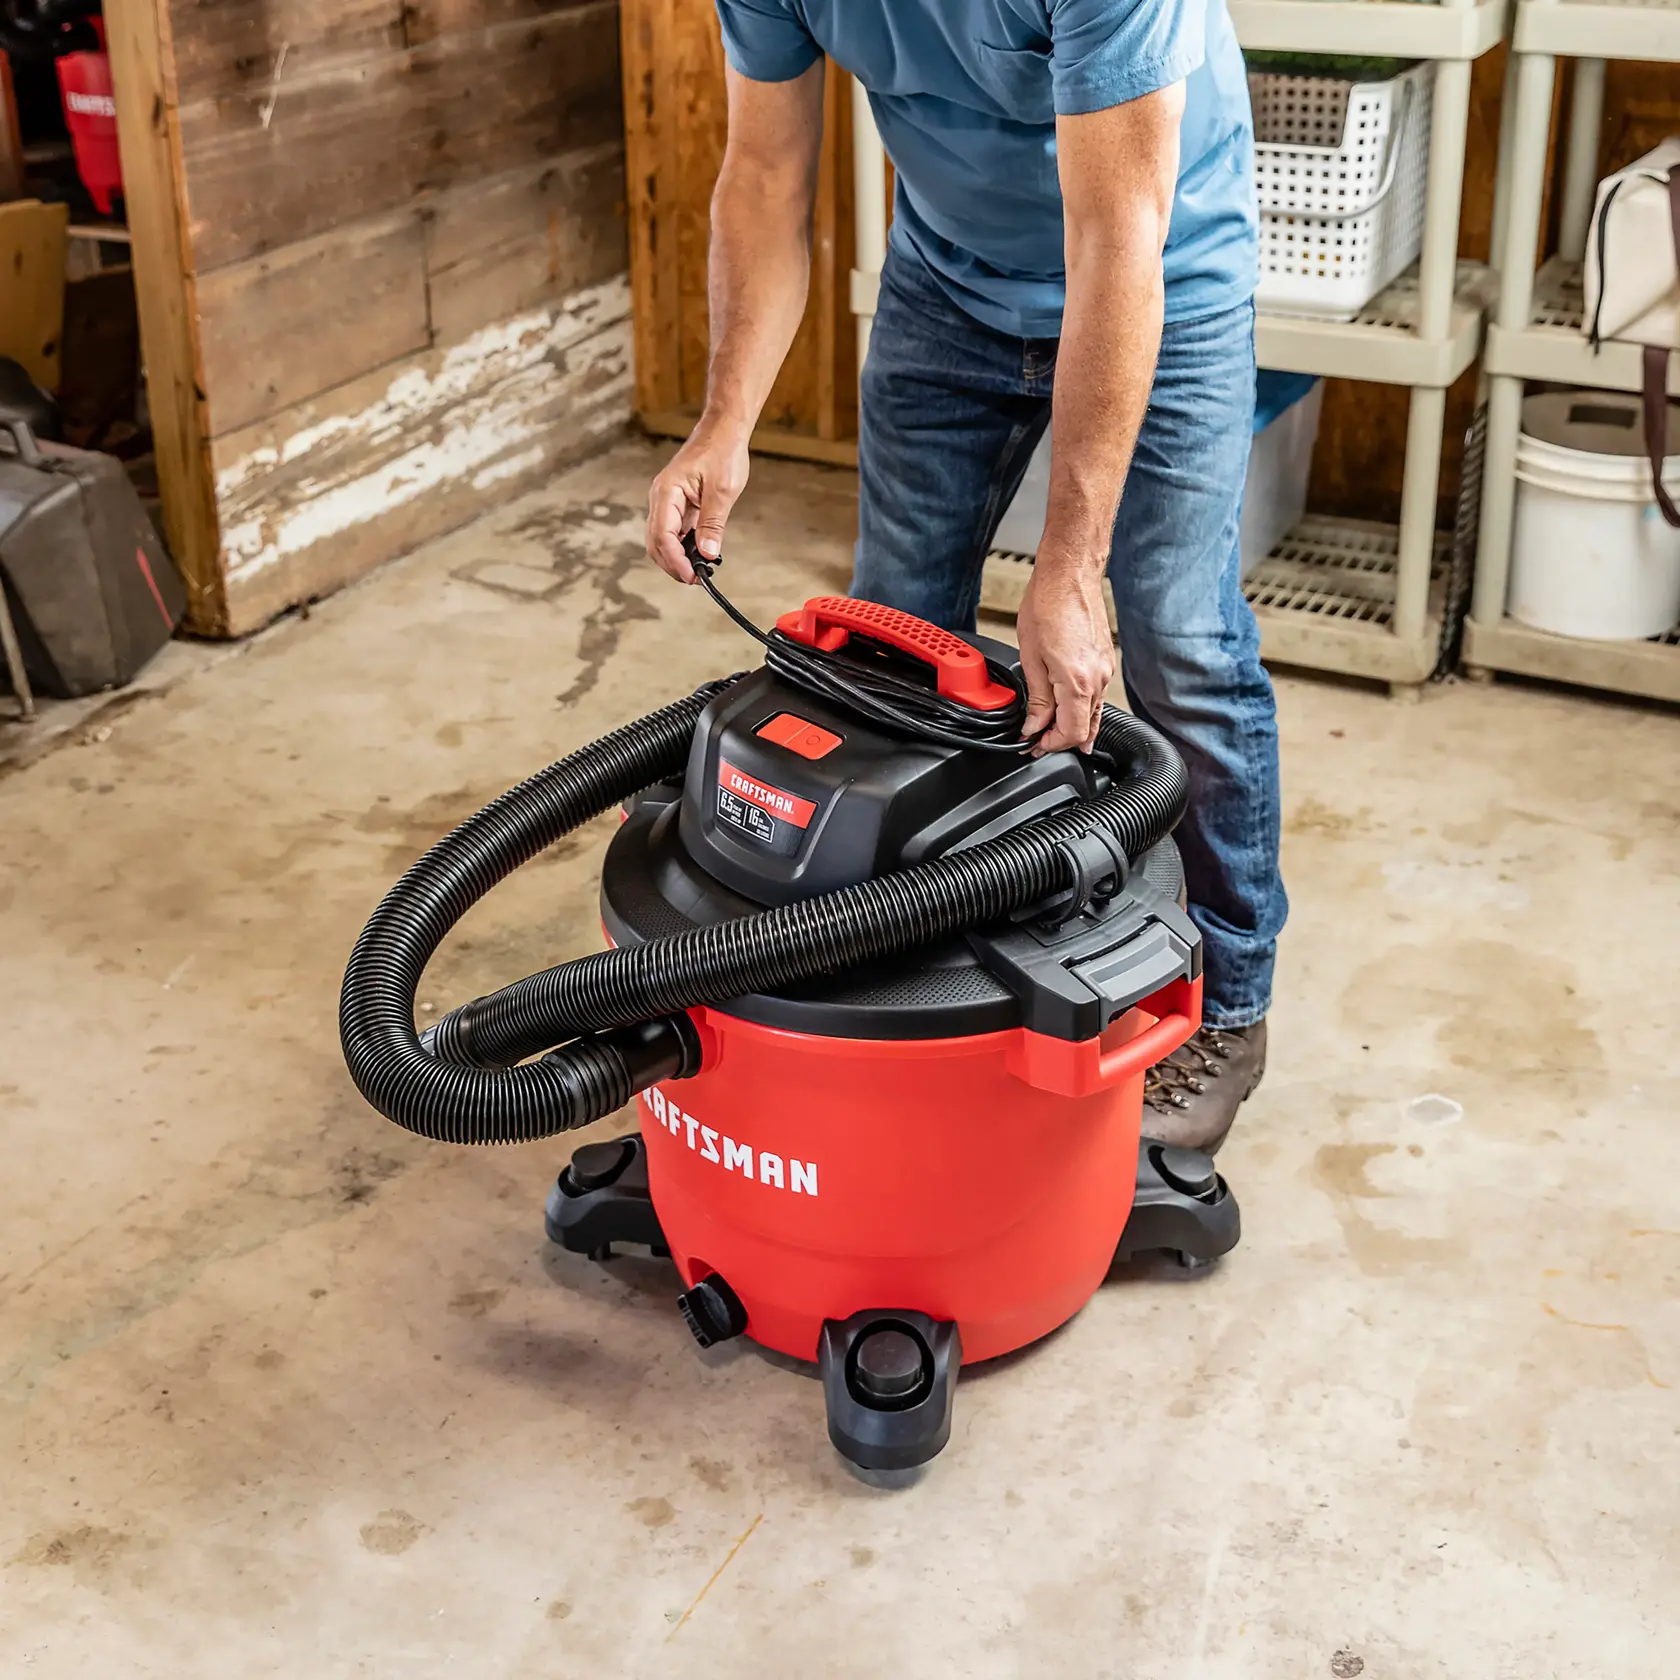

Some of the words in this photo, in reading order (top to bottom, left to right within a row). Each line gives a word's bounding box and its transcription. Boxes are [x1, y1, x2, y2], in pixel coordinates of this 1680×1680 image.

[720, 791, 734, 812] 6.5
[730, 773, 794, 814] CRAFTSMAN
[748, 807, 760, 826] 16
[642, 1086, 818, 1196] RAFTSMAN
